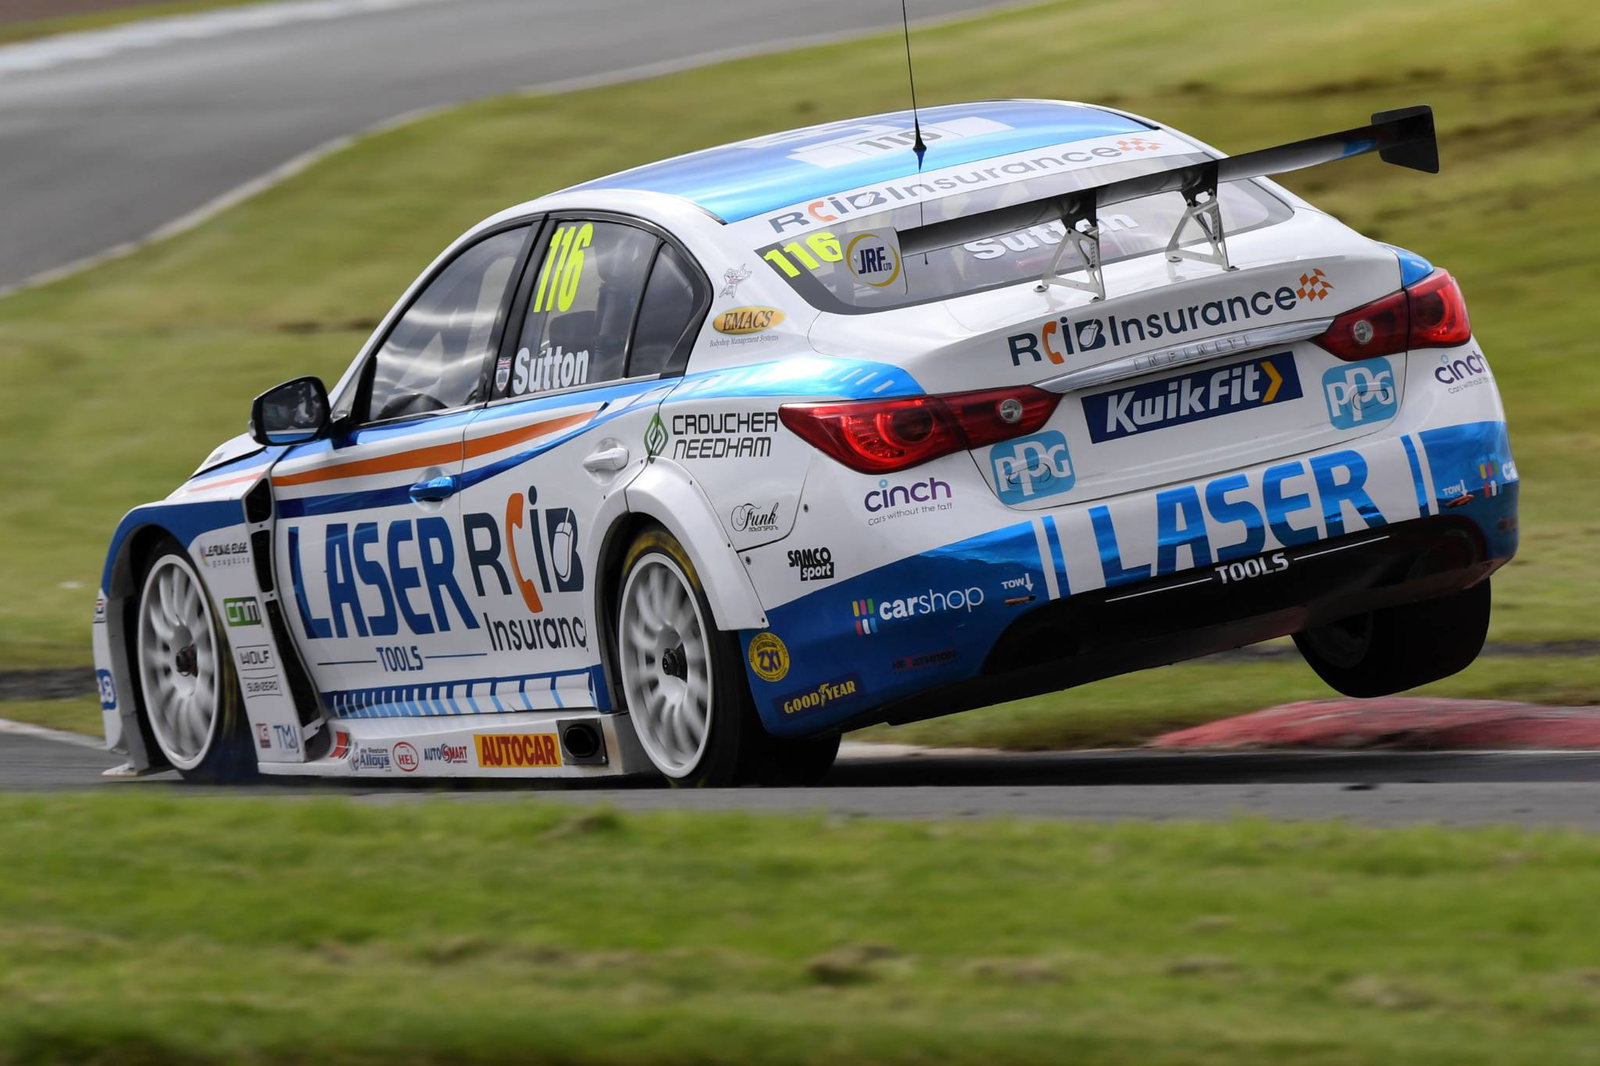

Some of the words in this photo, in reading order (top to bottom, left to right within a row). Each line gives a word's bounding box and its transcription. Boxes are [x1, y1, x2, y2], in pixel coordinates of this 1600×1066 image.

[856, 131, 942, 149] 116
[884, 143, 1122, 201] Insurance
[533, 222, 593, 312] 116
[763, 232, 843, 278] 116
[858, 247, 886, 274] JRF
[723, 311, 774, 331] EMACS
[1108, 286, 1297, 346] Insurance
[1133, 335, 1250, 370] INFINITI
[512, 346, 589, 394] Sutton
[1435, 351, 1486, 384] cinch
[672, 412, 778, 435] CROUCHER
[673, 437, 771, 460] NEEDHAM
[864, 477, 952, 513] cinch
[1442, 484, 1462, 496] TOW
[731, 502, 779, 532] Funk
[887, 508, 919, 520] without
[922, 505, 936, 513] the
[1088, 449, 1389, 588] LASER
[787, 547, 831, 567] SAMCO
[1215, 552, 1289, 584] TOOLS
[288, 516, 480, 639] LASER
[802, 563, 831, 580] sport
[1001, 578, 1024, 590] TOW
[879, 586, 984, 620] carshop
[484, 612, 588, 652] Insuranc
[241, 650, 269, 665] WOLF
[376, 645, 424, 672] TOOLS
[757, 650, 781, 672] ZX1
[893, 650, 956, 671] HEATHRON
[784, 680, 856, 714] GOODYEAR
[360, 754, 390, 768] Alloys
[398, 755, 416, 765] HEL
[481, 735, 558, 766] AUTOCAR
